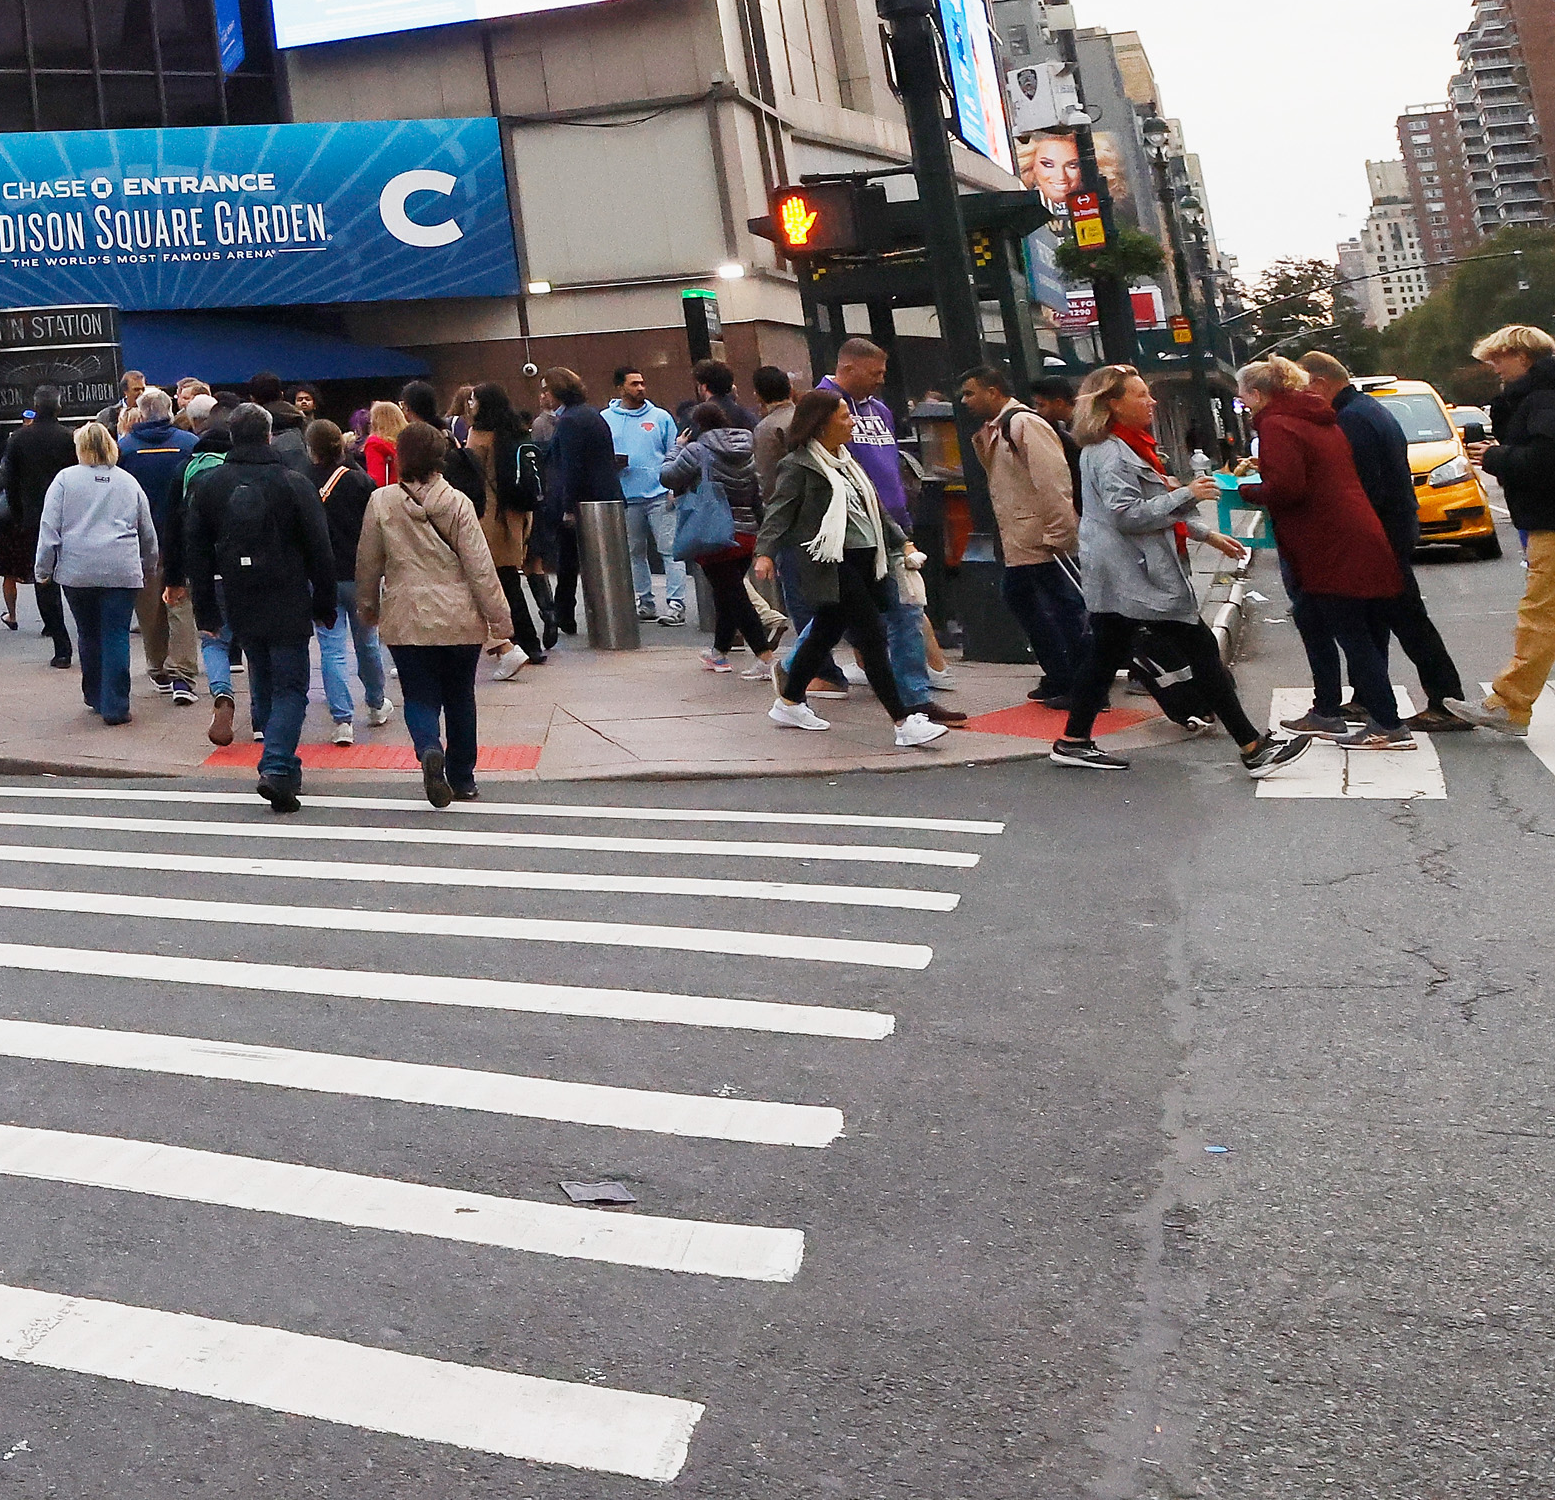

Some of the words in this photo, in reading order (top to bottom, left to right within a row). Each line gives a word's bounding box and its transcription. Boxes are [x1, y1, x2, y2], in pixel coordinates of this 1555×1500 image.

[2, 179, 87, 200] CHASE
[122, 172, 276, 197] ENTRANCE
[377, 169, 464, 249] C
[93, 204, 207, 254] SQUARE
[10, 258, 39, 268] THE
[45, 255, 111, 267] WORLD'S
[116, 253, 156, 264] MOST
[162, 251, 221, 262] FAMOUS
[226, 249, 273, 260] ARENA
[31, 313, 103, 339] STATION
[76, 381, 114, 402] GARDEN
